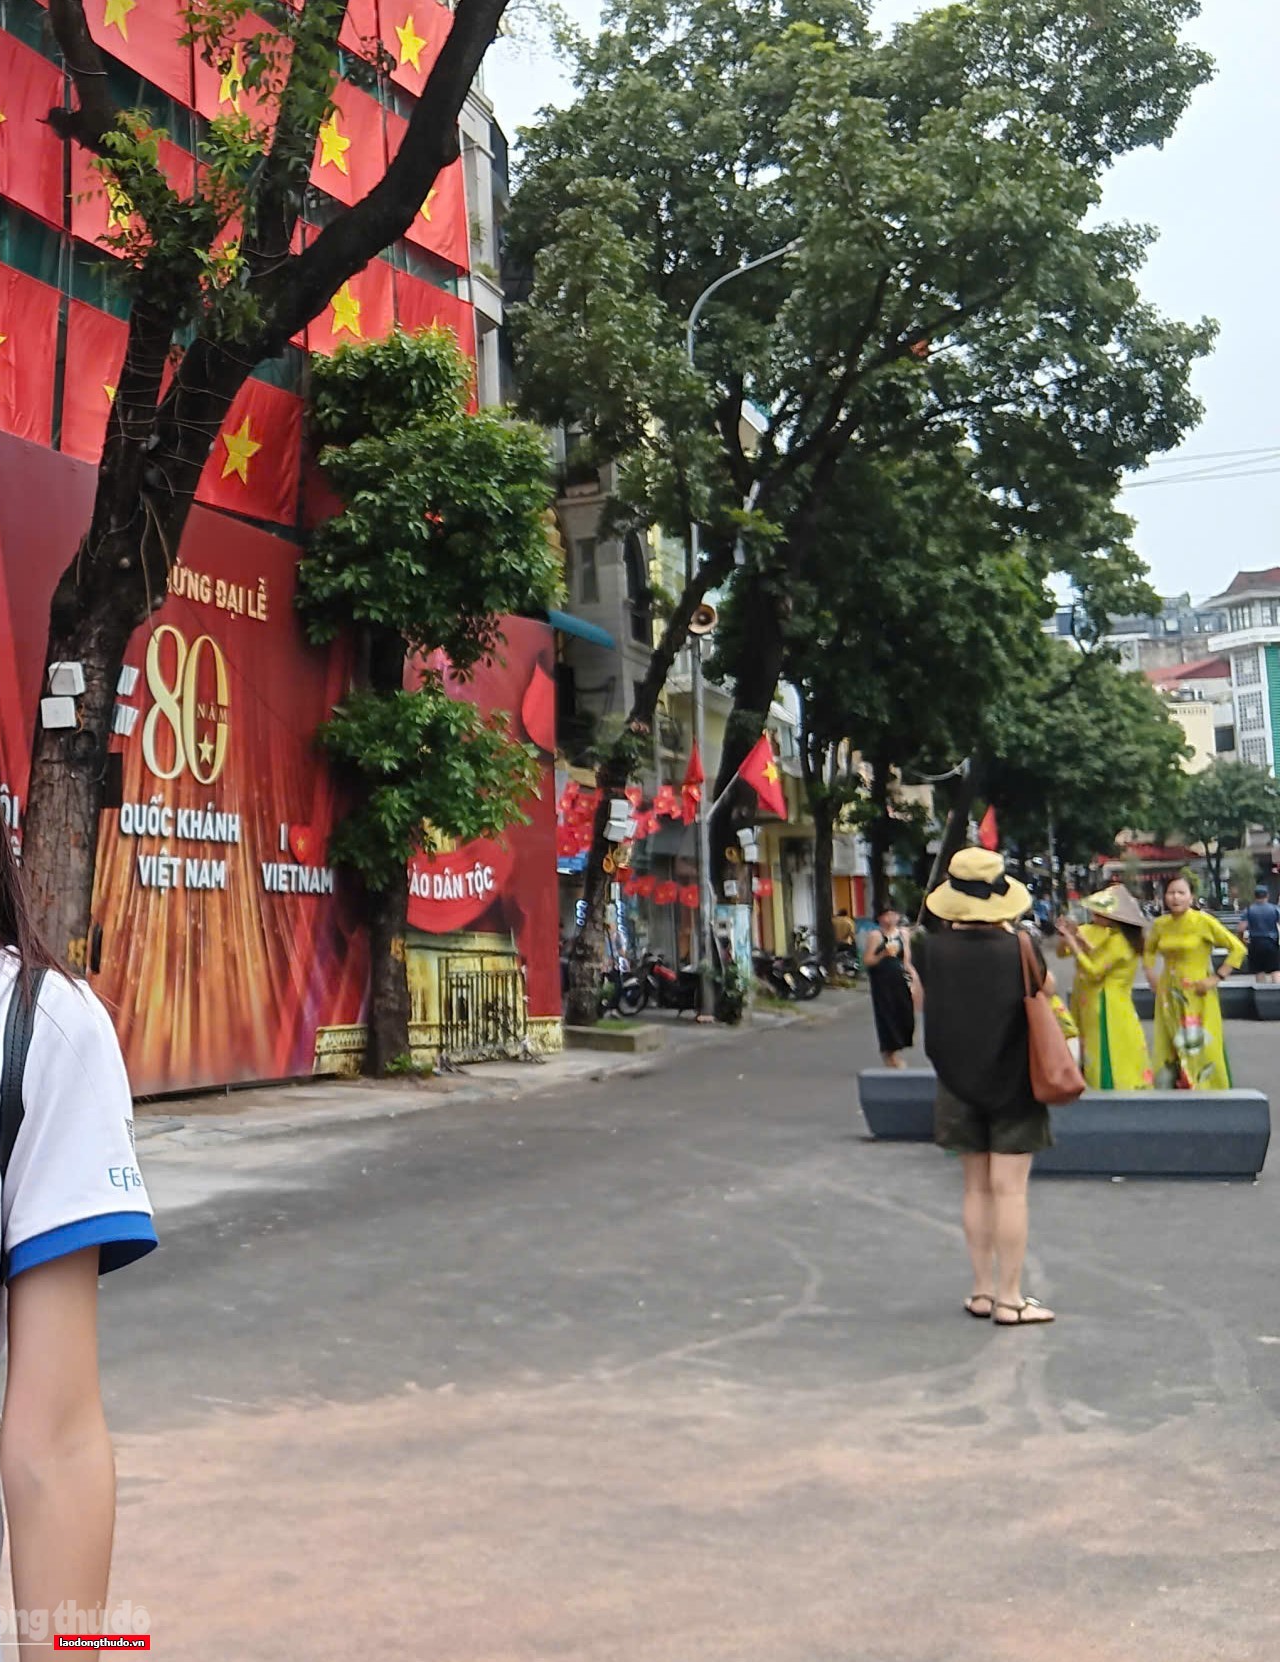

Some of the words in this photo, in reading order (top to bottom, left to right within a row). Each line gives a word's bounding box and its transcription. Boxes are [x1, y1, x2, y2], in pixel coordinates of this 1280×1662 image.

[215, 579, 244, 619] ĐẠI
[247, 577, 268, 622] LỄ
[143, 625, 228, 784] 80
[120, 794, 173, 838] QUỐC
[177, 802, 240, 843] KHÁNH
[280, 822, 288, 851] I
[138, 846, 182, 895] VIỆT
[185, 857, 226, 889] NAM
[262, 862, 334, 894] VIETNAM
[407, 863, 430, 897] ÀO
[433, 867, 464, 900] DÂN
[465, 862, 495, 900] TỘC
